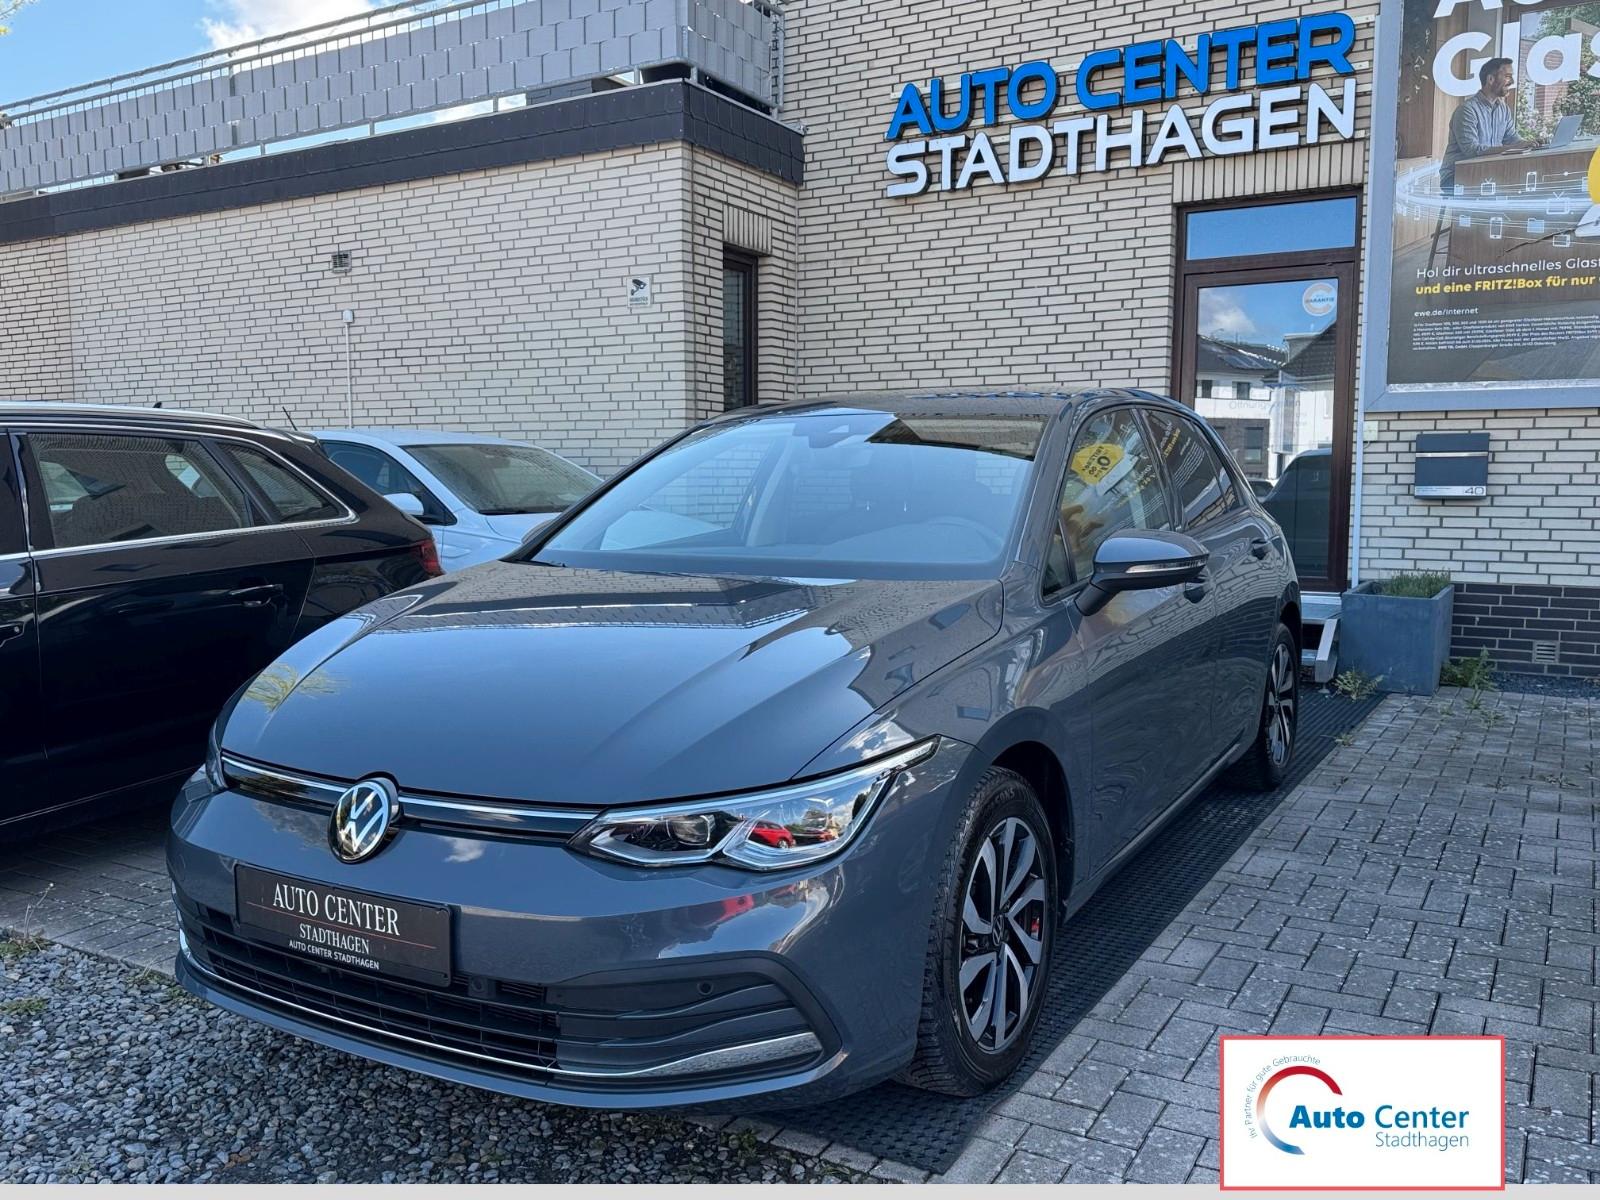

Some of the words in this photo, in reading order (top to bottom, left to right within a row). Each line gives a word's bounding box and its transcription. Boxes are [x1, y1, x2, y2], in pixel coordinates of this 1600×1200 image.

[1432, 21, 1600, 97] Gla
[886, 61, 1058, 141] AUTO
[1076, 12, 1355, 110] CENTER
[885, 78, 1357, 198] STADTHAGEN
[1415, 282, 1441, 295] und
[1443, 281, 1472, 293] eine
[1474, 278, 1542, 292] FRITZ!Box
[1545, 275, 1567, 287] für
[1570, 275, 1596, 286] nur
[1416, 267, 1439, 279] Hol
[1442, 265, 1461, 277] dir
[1464, 259, 1562, 275] ultraschnelles
[1413, 307, 1479, 318] ewe.de/internet
[1464, 486, 1485, 496] 40
[272, 882, 319, 917] AUTO
[324, 894, 400, 936] CENTER
[288, 939, 306, 952] AUTO
[307, 945, 333, 960] CENTER
[333, 952, 380, 970] STADTHAGEN
[299, 922, 370, 955] STADTHAGEN
